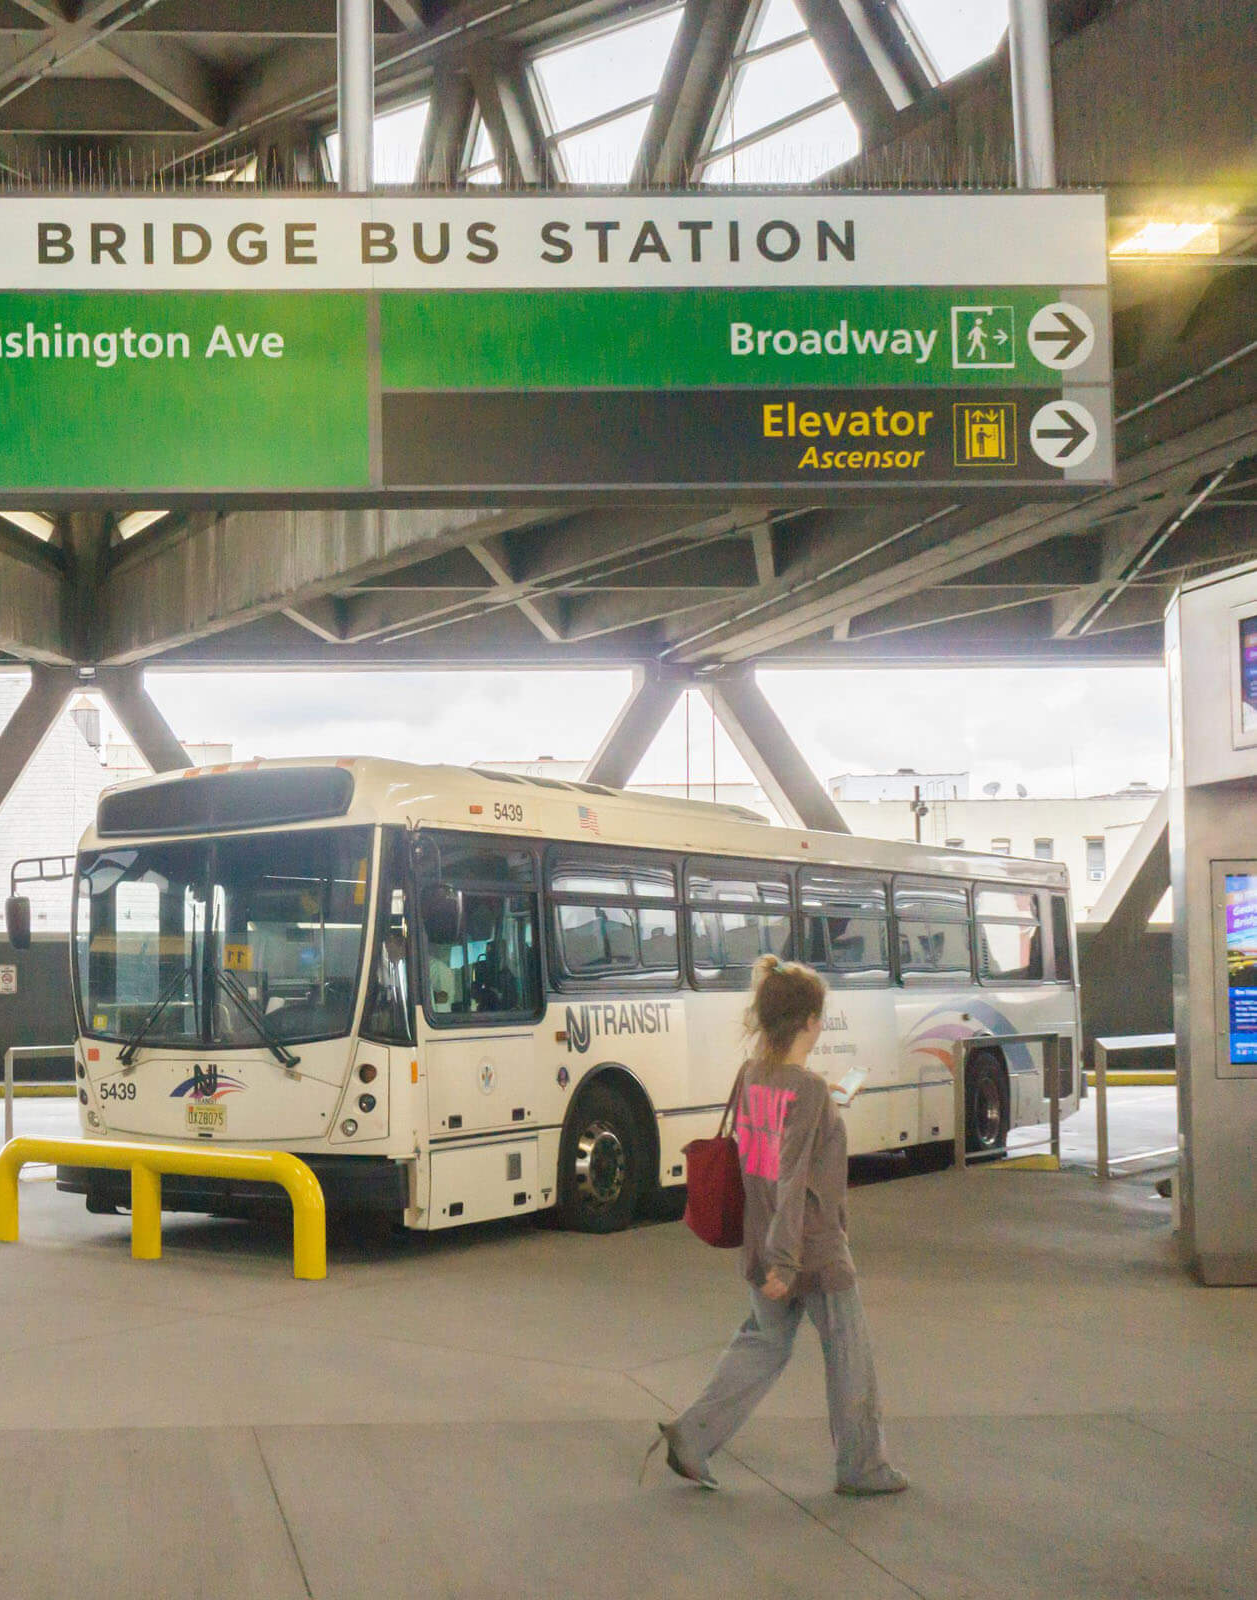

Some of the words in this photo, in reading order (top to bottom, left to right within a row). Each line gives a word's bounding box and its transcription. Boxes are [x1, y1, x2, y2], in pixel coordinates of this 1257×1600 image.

[37, 222, 319, 265] BRIDGE
[361, 221, 499, 264] BUS
[541, 219, 857, 263] STATION
[206, 324, 285, 359] Ave
[730, 320, 938, 364] Broadway
[763, 401, 934, 438] Elevator
[797, 446, 926, 470] Ascensor
[493, 802, 524, 823] 5439
[566, 1004, 591, 1054] NJ
[590, 1002, 672, 1035] TRANSIT
[100, 1082, 137, 1101] 5439
